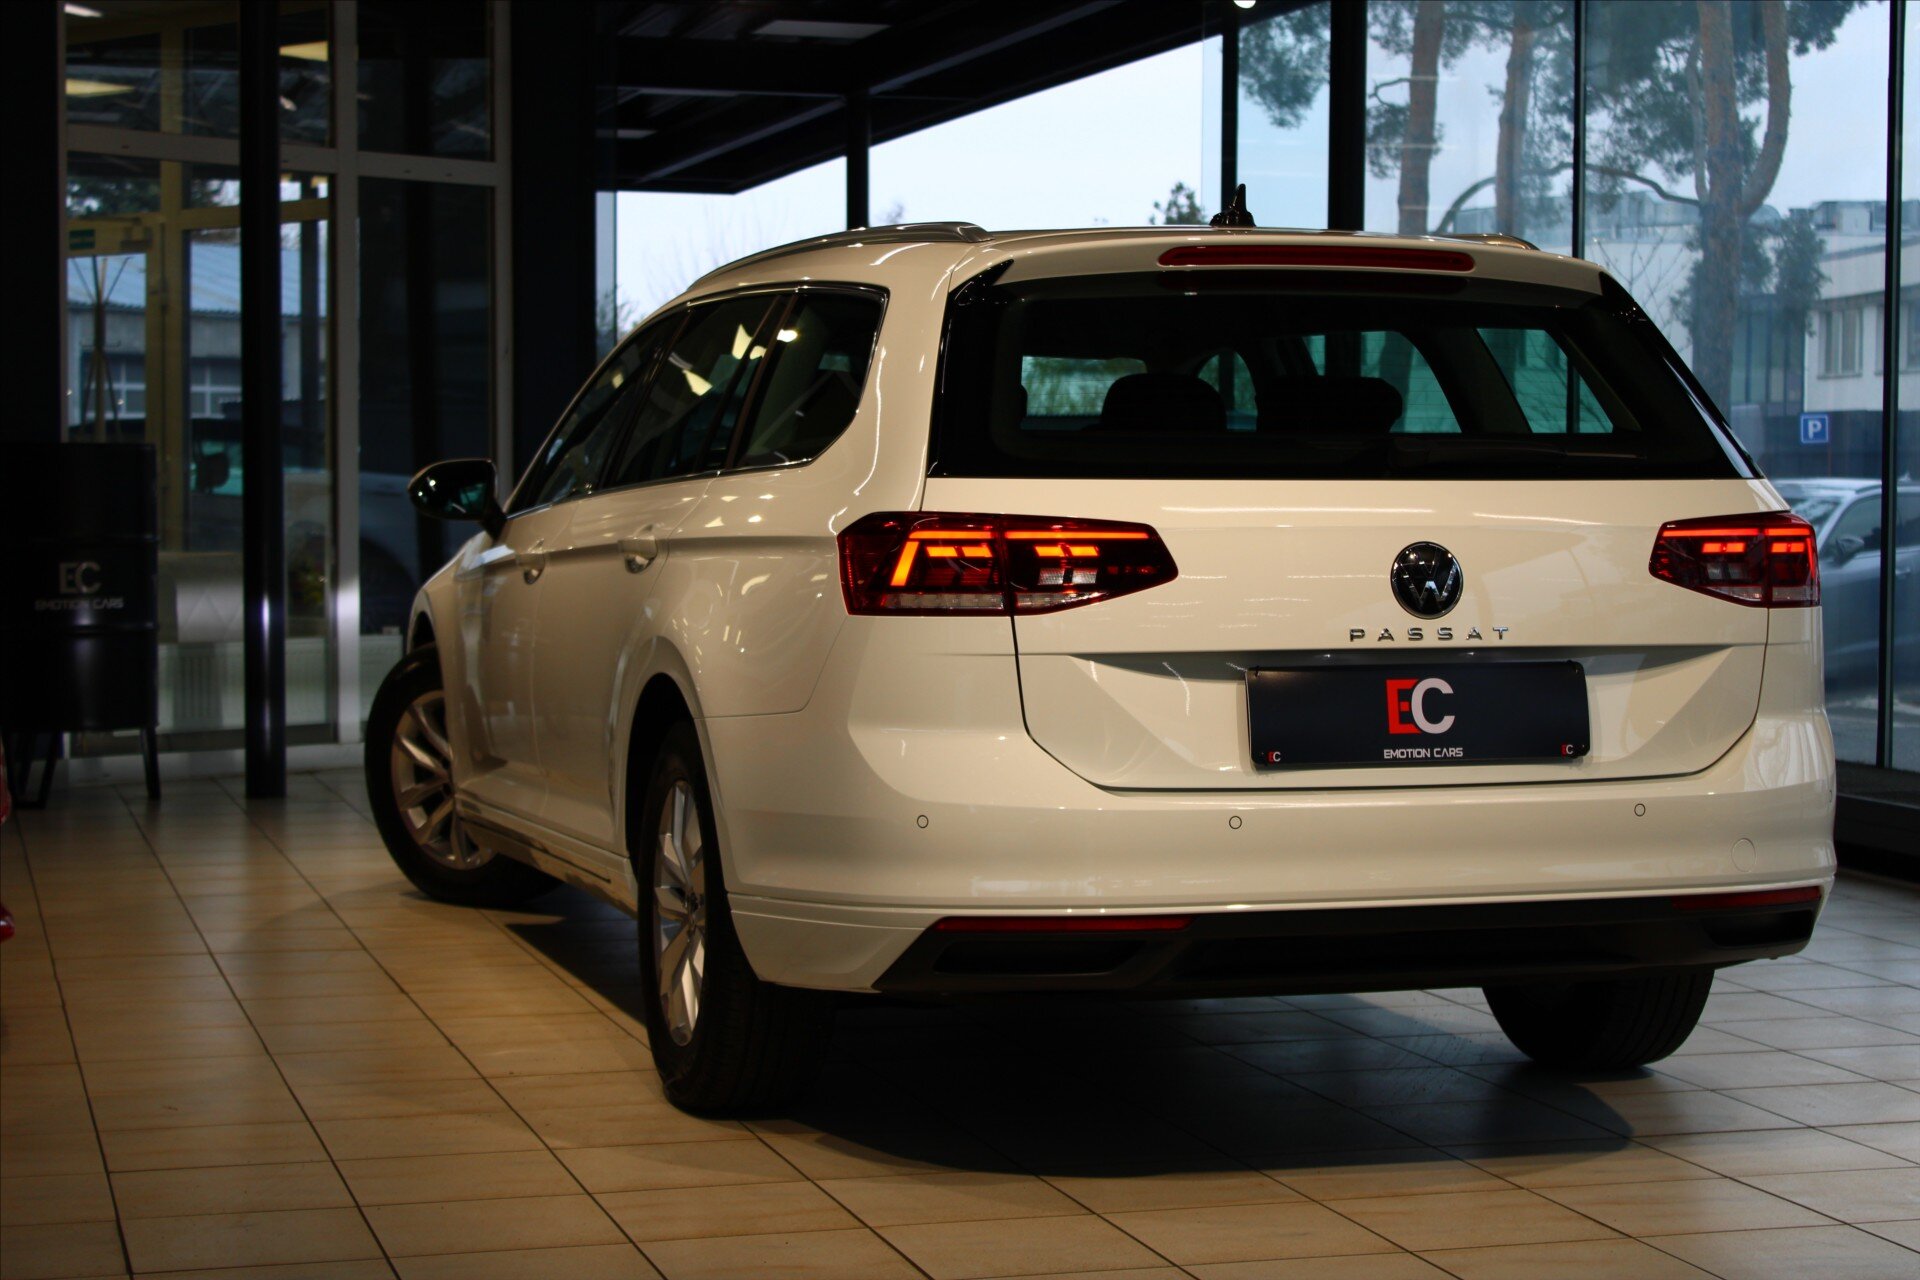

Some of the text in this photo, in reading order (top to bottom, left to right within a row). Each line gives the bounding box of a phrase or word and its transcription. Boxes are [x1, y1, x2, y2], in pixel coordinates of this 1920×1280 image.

[1808, 420, 1822, 439] P
[59, 562, 101, 593] EC
[93, 598, 124, 609] CARS
[1350, 627, 1509, 642] PASSAT
[1386, 678, 1455, 734] EC
[1383, 747, 1464, 759] EMOTION CARS
